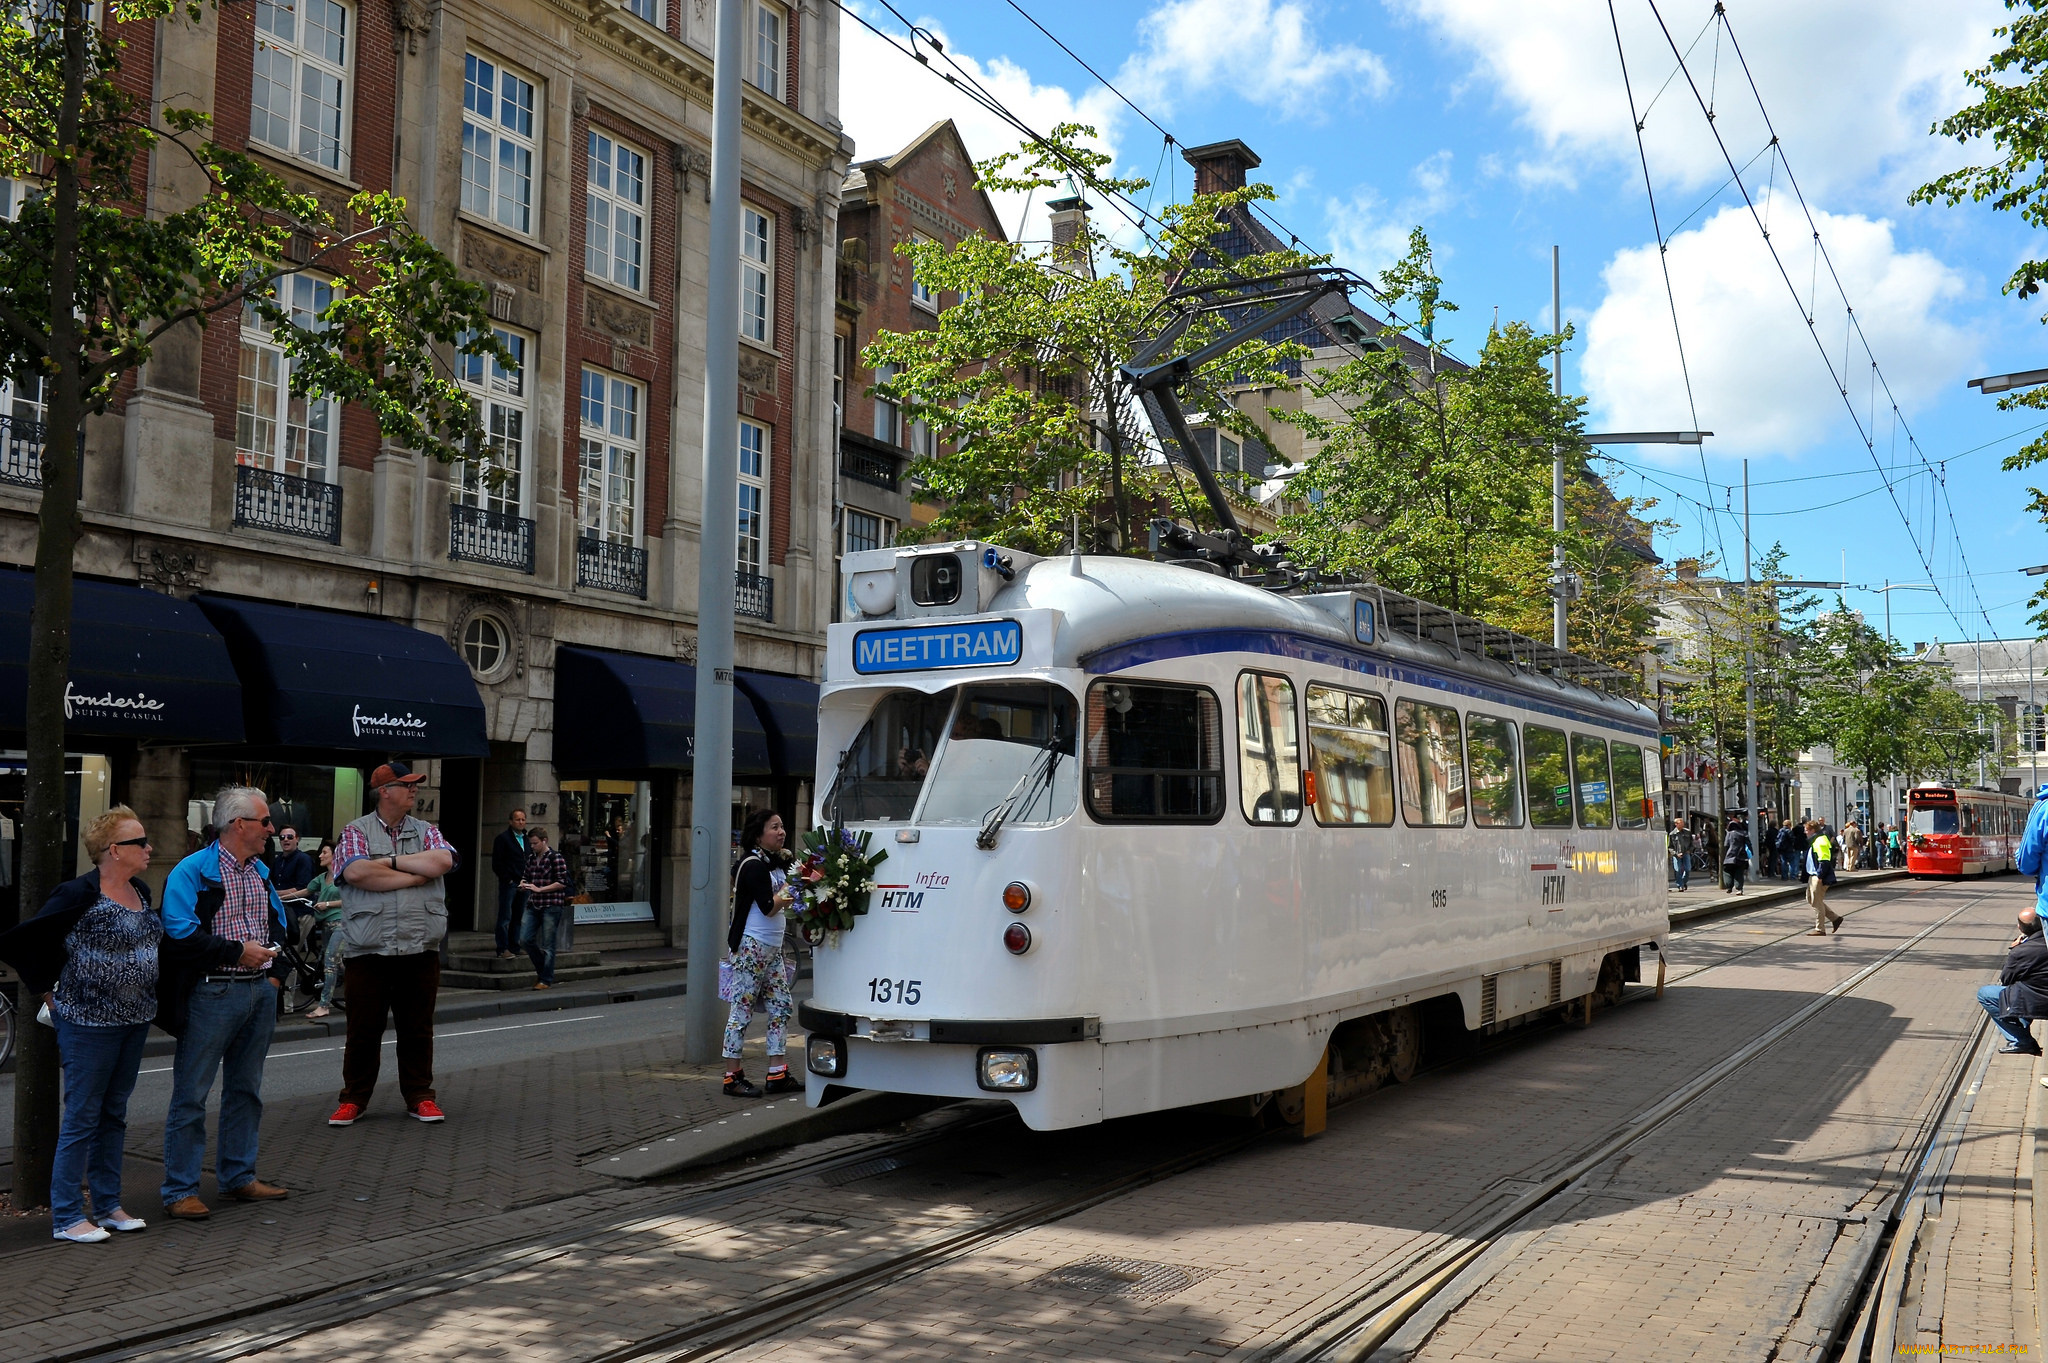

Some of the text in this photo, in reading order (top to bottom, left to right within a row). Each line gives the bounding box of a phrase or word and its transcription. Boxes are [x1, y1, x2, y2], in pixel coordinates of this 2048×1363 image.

[859, 629, 1017, 665] MEETTRAM
[63, 681, 165, 720] fonderie
[75, 708, 107, 718] SUITS
[124, 711, 164, 721] CASUAL
[352, 703, 427, 737] fonderie
[360, 727, 385, 735] SUITS
[396, 729, 426, 738] CASUAL
[915, 871, 950, 889] Infra
[1542, 875, 1566, 906] HTM
[881, 891, 925, 909] HTM
[1430, 889, 1447, 908] 1315
[868, 977, 922, 1006] 1315
